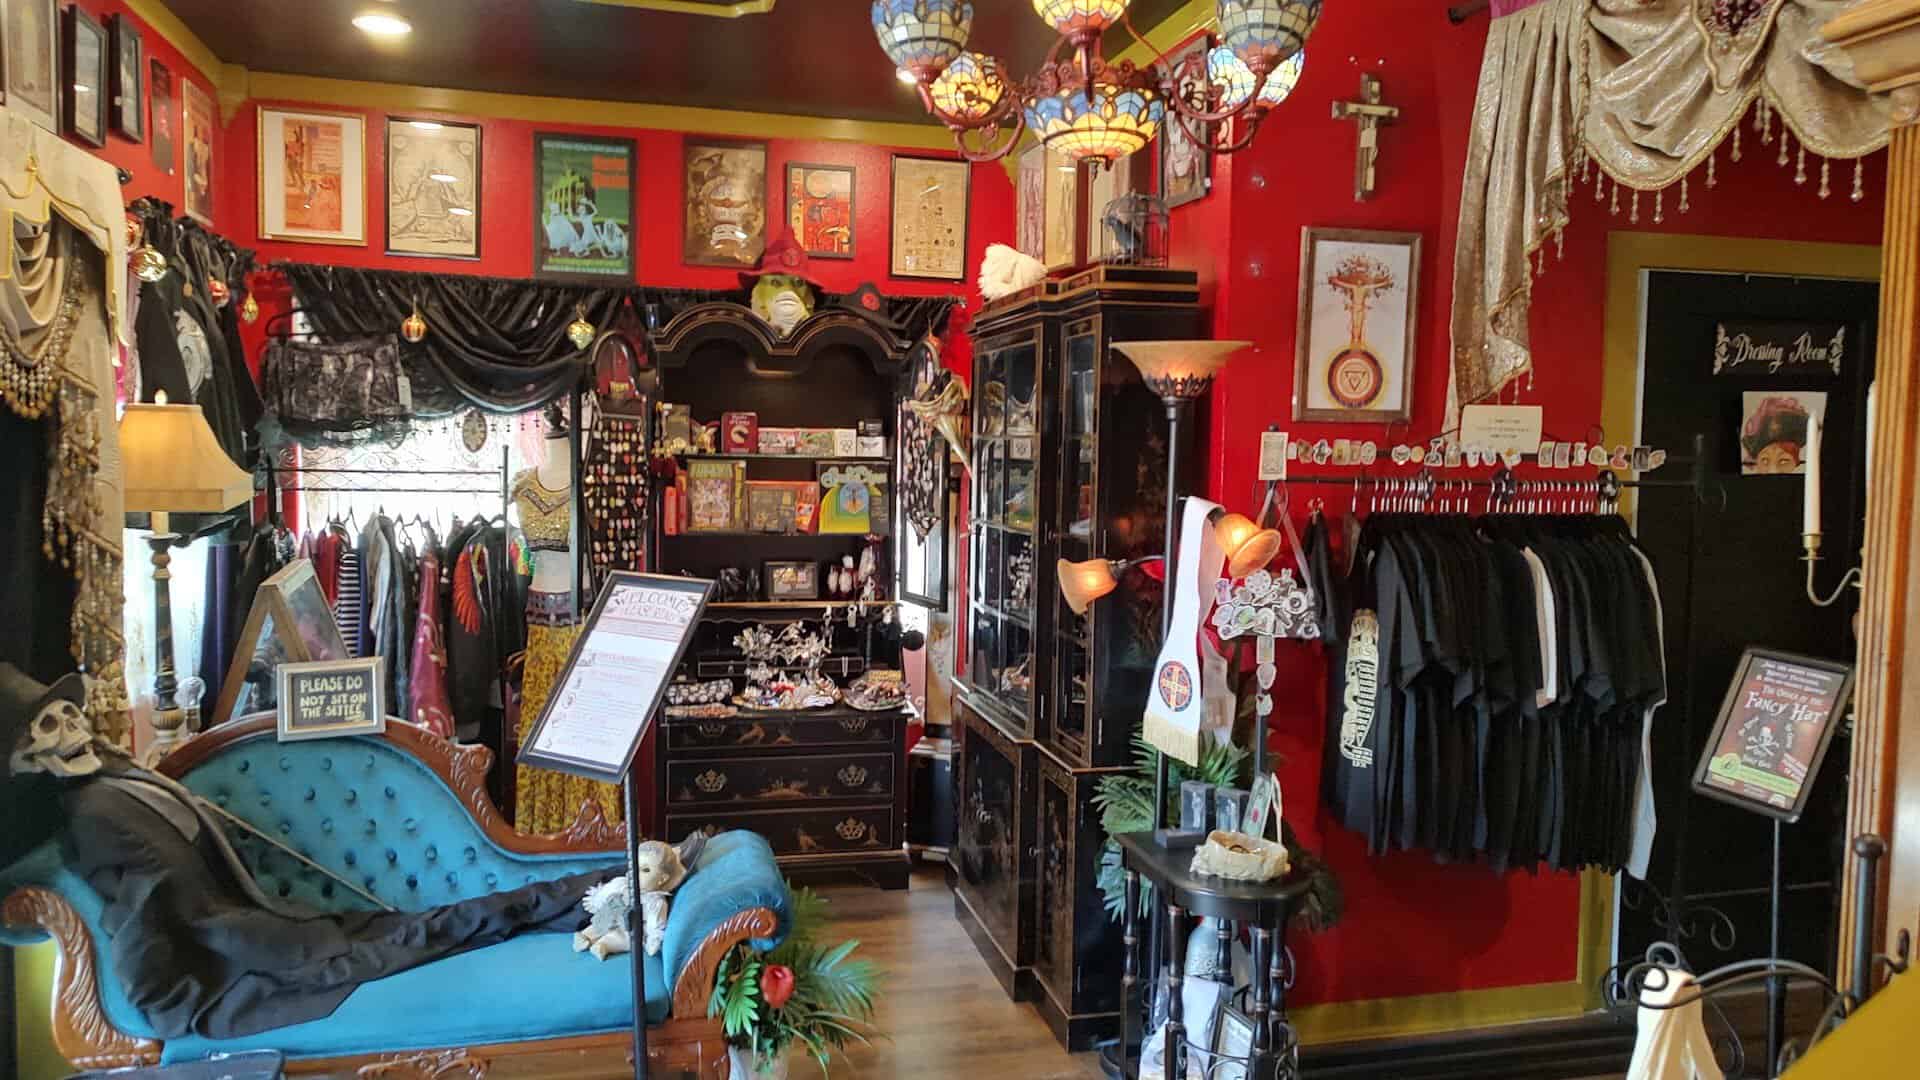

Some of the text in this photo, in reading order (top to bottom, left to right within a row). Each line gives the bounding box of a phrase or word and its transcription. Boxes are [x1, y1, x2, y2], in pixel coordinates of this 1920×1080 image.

[1731, 331, 1827, 375] Dressing Room
[300, 675, 363, 693] PLEASE DO
[300, 692, 367, 707] NOT SIT ON
[1745, 691, 1788, 715] Fancy
[301, 703, 362, 720] THE SETTEE
